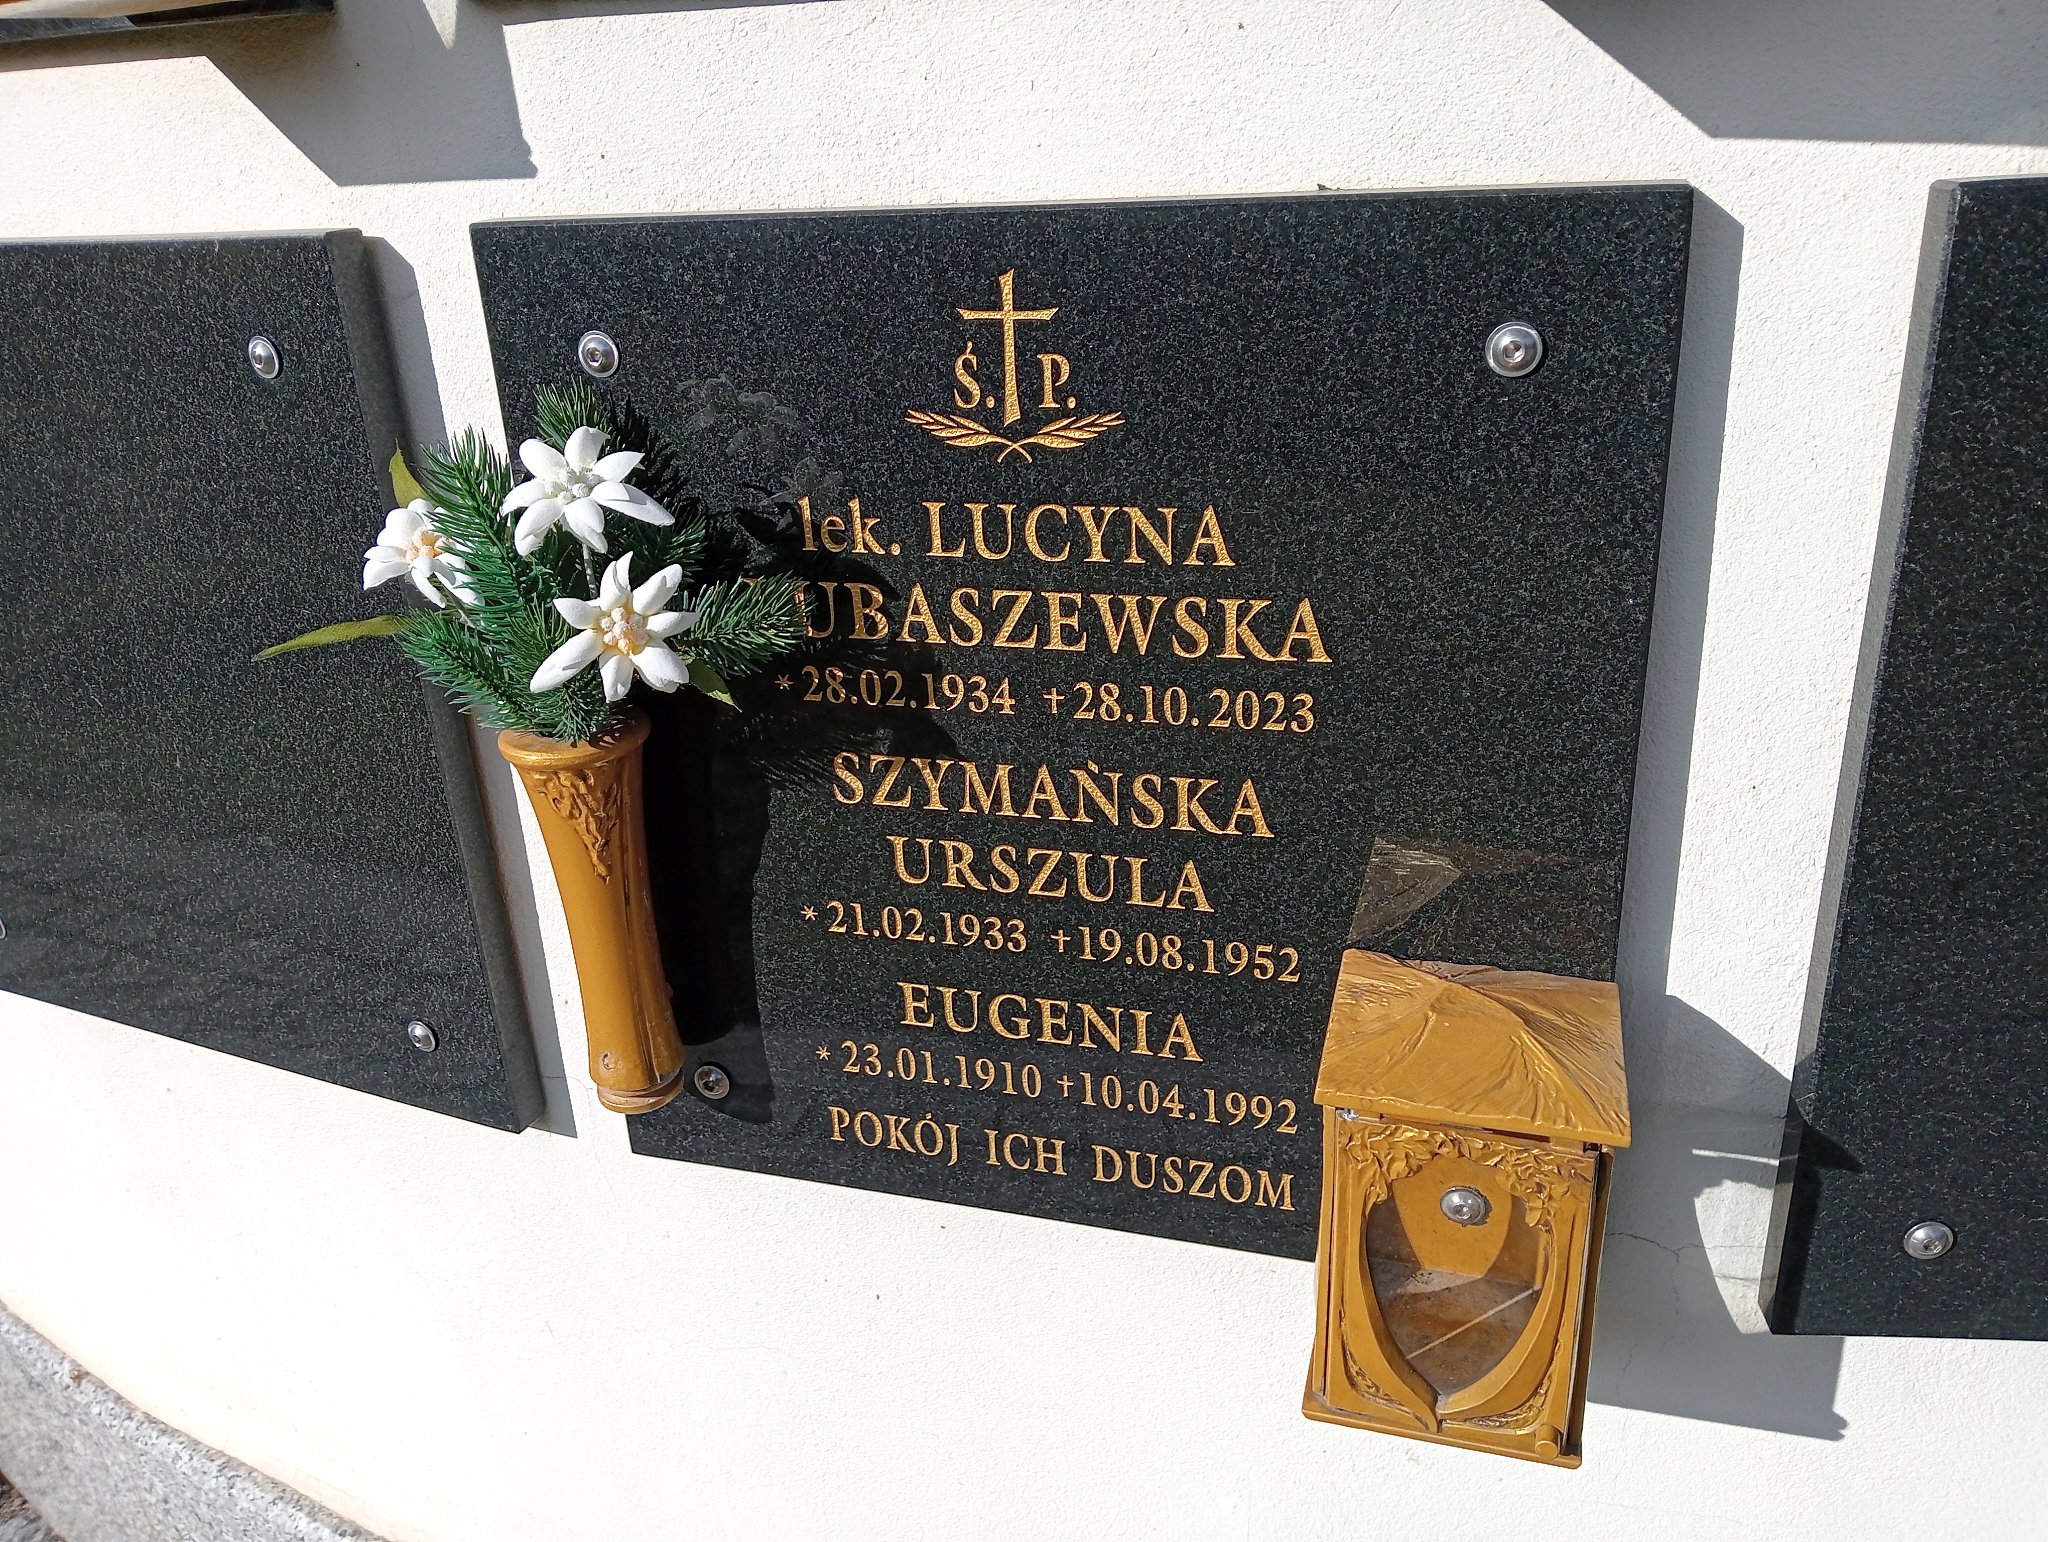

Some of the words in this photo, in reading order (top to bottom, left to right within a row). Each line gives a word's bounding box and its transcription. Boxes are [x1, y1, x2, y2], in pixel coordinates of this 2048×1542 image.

[953, 340, 996, 410] Ś.
[1036, 351, 1077, 410] P.
[798, 495, 902, 556] lek.
[922, 500, 1237, 568] LUCYNA
[741, 576, 1333, 665] UBASZEWSKA
[886, 834, 1215, 913] URSZULA
[896, 981, 1204, 1063] EUGENIA
[827, 1105, 961, 1167] POKÓJ
[986, 1129, 1067, 1177] ICH
[1092, 1144, 1296, 1213] DUSZOM
